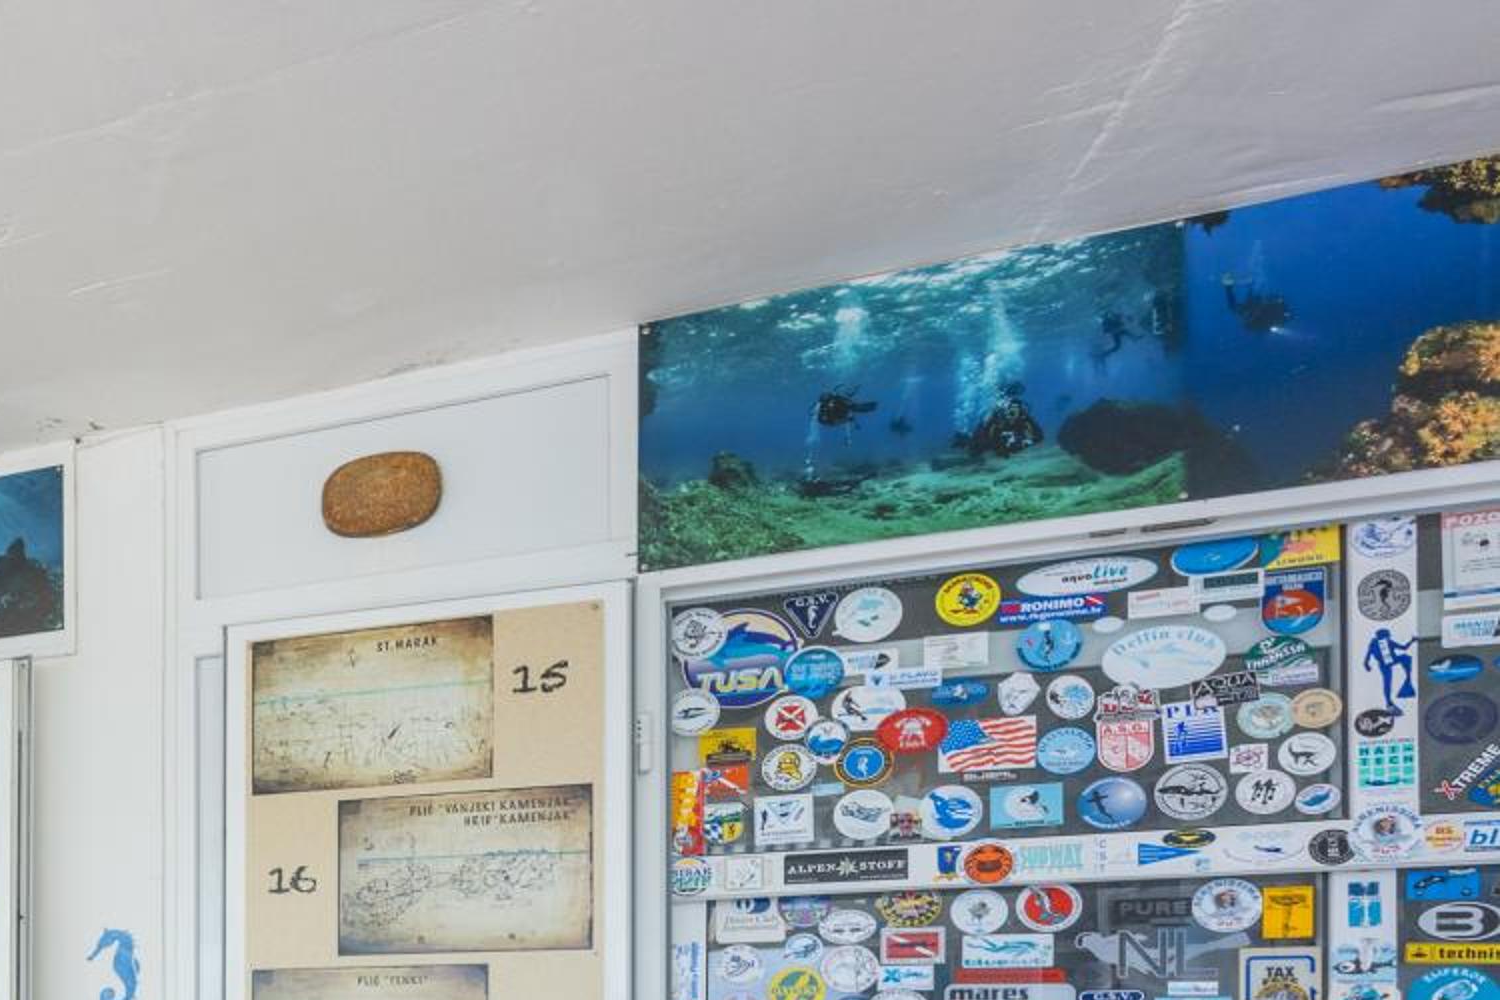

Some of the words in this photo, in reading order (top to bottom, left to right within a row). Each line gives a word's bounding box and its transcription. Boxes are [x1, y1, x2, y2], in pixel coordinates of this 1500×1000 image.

[511, 659, 569, 694] 15
[697, 667, 784, 693] TUSA
[267, 865, 317, 895] 16
[1119, 900, 1189, 917] PURE
[1265, 965, 1295, 979] TAX
[949, 986, 1029, 1000] mares
